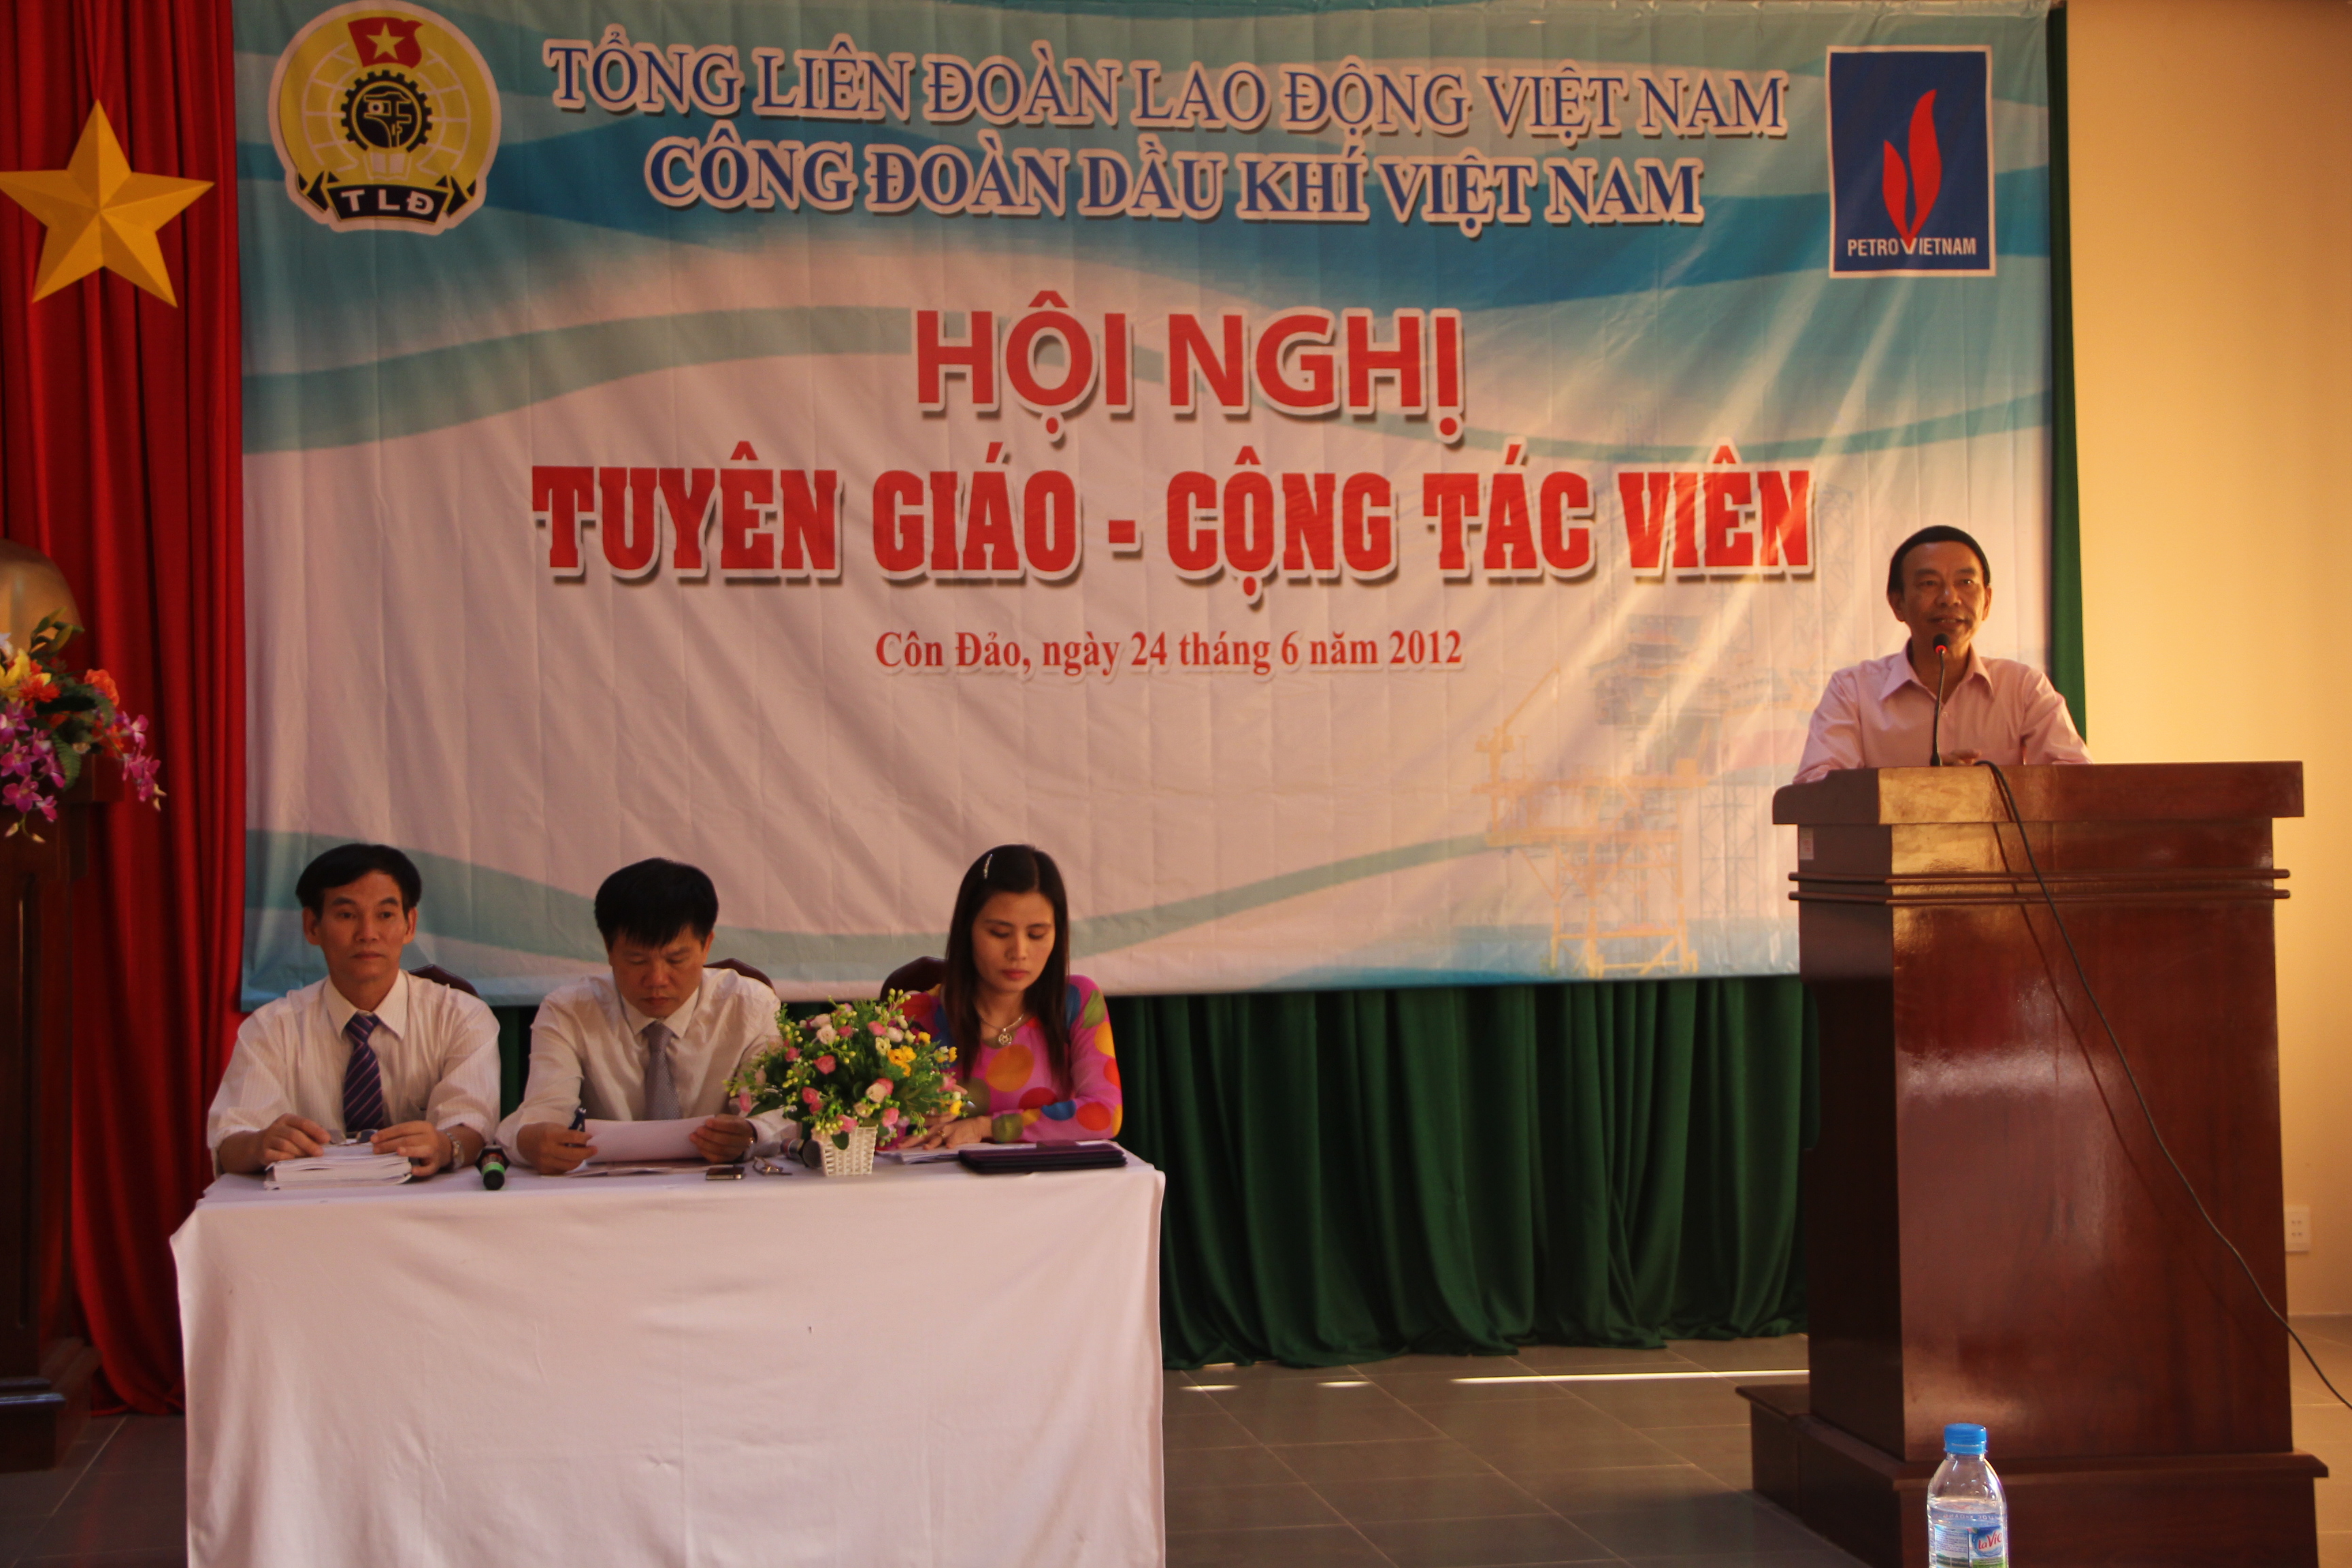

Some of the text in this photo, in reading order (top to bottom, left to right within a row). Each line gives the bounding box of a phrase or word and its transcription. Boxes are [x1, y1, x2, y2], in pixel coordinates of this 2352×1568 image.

[549, 31, 1784, 140] TỔNG LIÊN ĐOÀN LAO ĐỘNG VIỆT NAM
[651, 128, 1702, 230] CÔNG ĐOÀN DẦU KHÍ VIỆT NAM
[917, 291, 1458, 436] HỘI NGHỊ
[532, 440, 1810, 596] TUYÊN GIÁO - CỘNG TÁC VIÊN
[876, 630, 1462, 676] Côn Đảo, ngày 24 tháng 6 năm 2012
